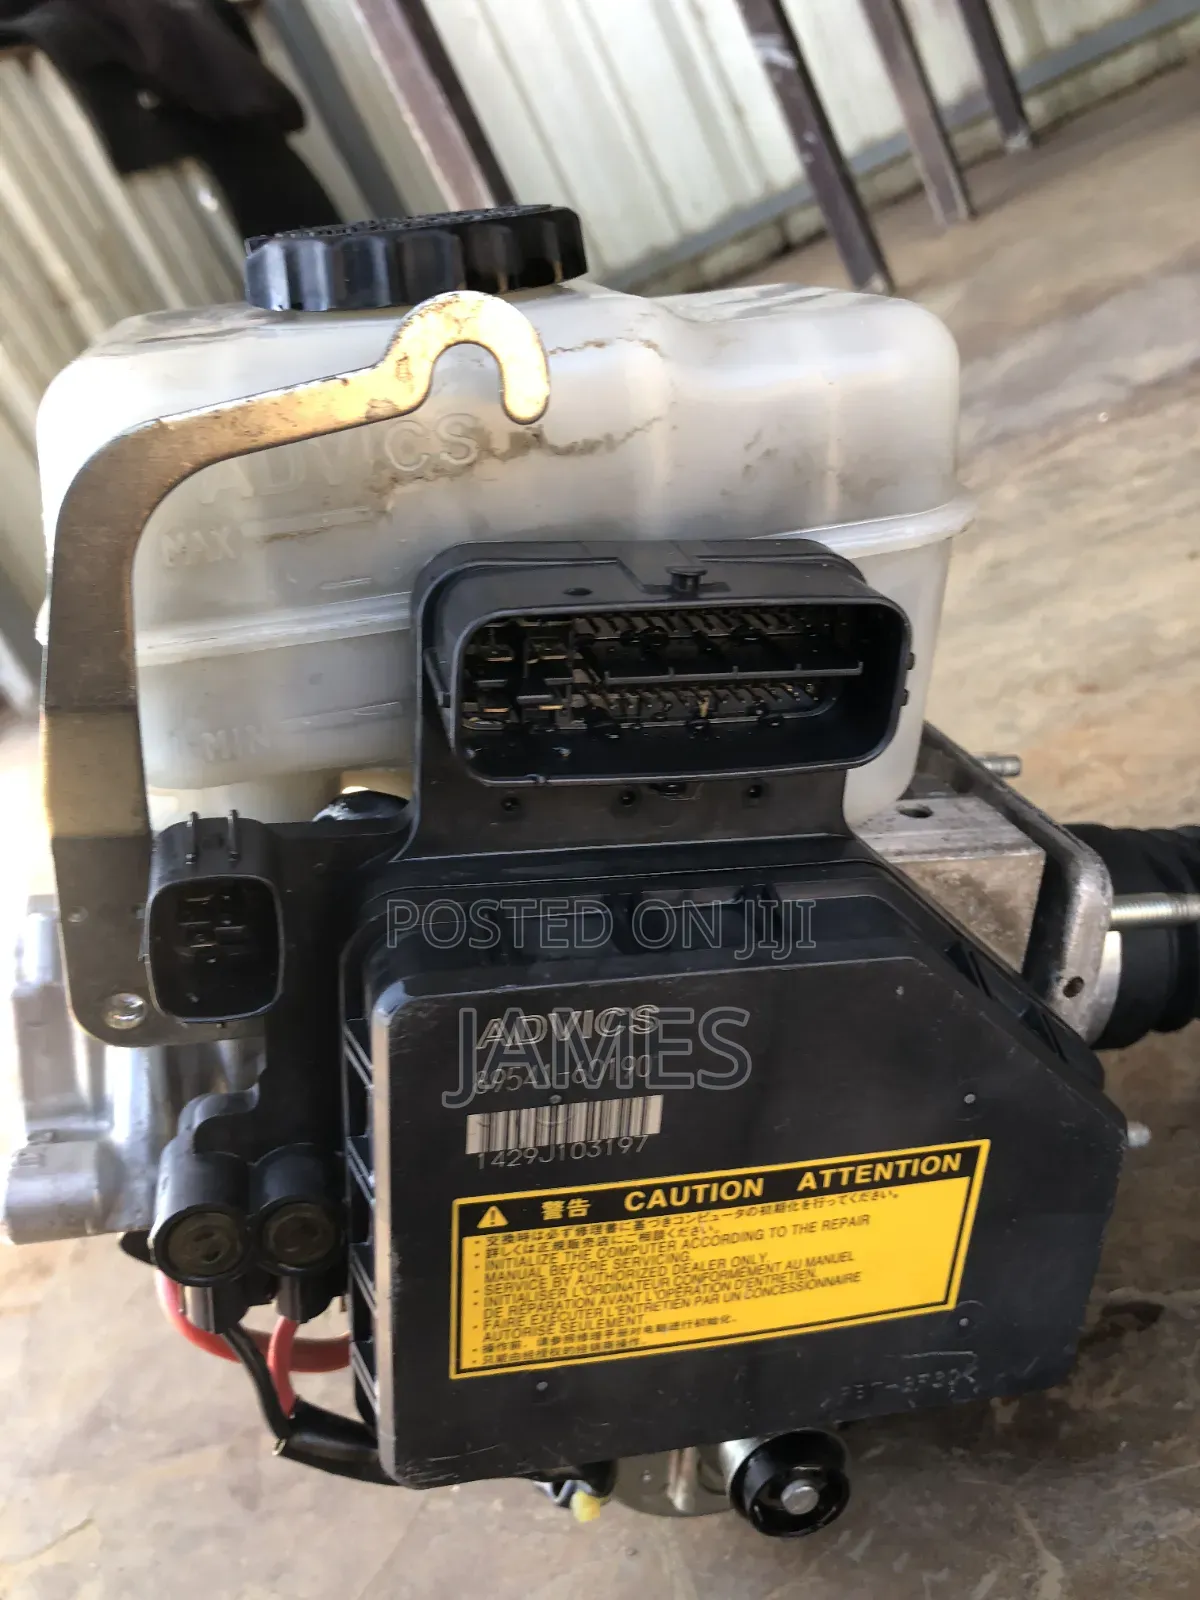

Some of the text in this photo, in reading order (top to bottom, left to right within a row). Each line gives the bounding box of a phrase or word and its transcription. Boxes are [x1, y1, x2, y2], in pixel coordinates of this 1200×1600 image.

[476, 1004, 660, 1050] ADVICS
[477, 1134, 649, 1170] 1429J103197
[624, 1152, 962, 1212] CAUTION ATTENTION
[541, 1198, 592, 1222] 警告
[485, 1214, 871, 1270] INITIALIZE THE COMPUTER ACCORDING TO THE REPAIR
[484, 1267, 542, 1282] MANUAL
[549, 1260, 609, 1277] BEFORE
[484, 1278, 549, 1296] SERVICE
[552, 1276, 570, 1289] BY
[574, 1265, 668, 1287] AUTHORIZED
[672, 1258, 726, 1276] DEALER
[484, 1287, 568, 1308] INITIALISER
[784, 1259, 803, 1271] AU
[805, 1251, 855, 1268] MANUEL
[483, 1317, 525, 1331] FAIRE
[694, 1293, 720, 1307] PAR
[723, 1291, 741, 1303] UN
[743, 1271, 862, 1300] CONCESSIONNAIRE
[484, 1305, 503, 1321] DE
[600, 1291, 643, 1306] AVANT
